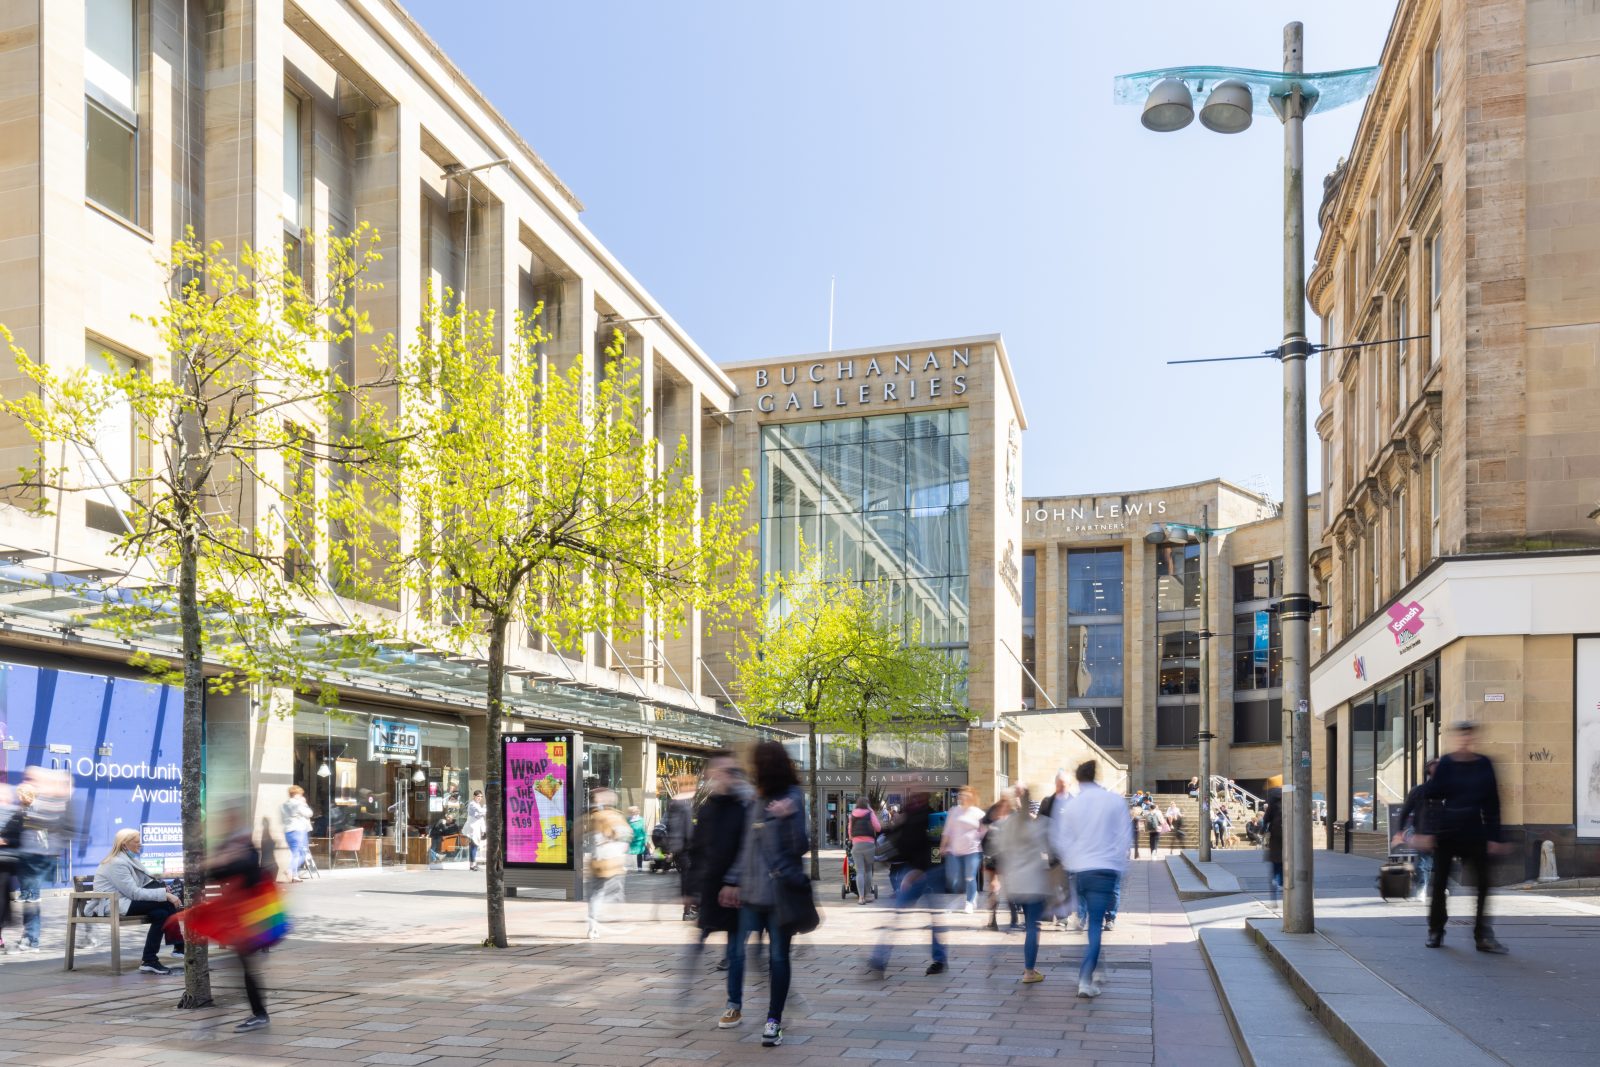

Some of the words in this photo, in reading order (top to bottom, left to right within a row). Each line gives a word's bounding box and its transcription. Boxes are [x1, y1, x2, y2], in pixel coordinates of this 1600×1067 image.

[756, 348, 970, 388] BUCHANAN
[757, 376, 968, 413] GALLERIES
[1025, 507, 1083, 524] JOHN
[1095, 501, 1166, 518] LEWIS
[1075, 523, 1125, 532] PARTNERS
[1392, 606, 1419, 632] iSmash
[382, 732, 416, 747] NERO
[77, 757, 183, 785] Opportunity
[511, 759, 548, 779] WRAP
[515, 786, 533, 799] THE
[510, 797, 534, 816] DAY
